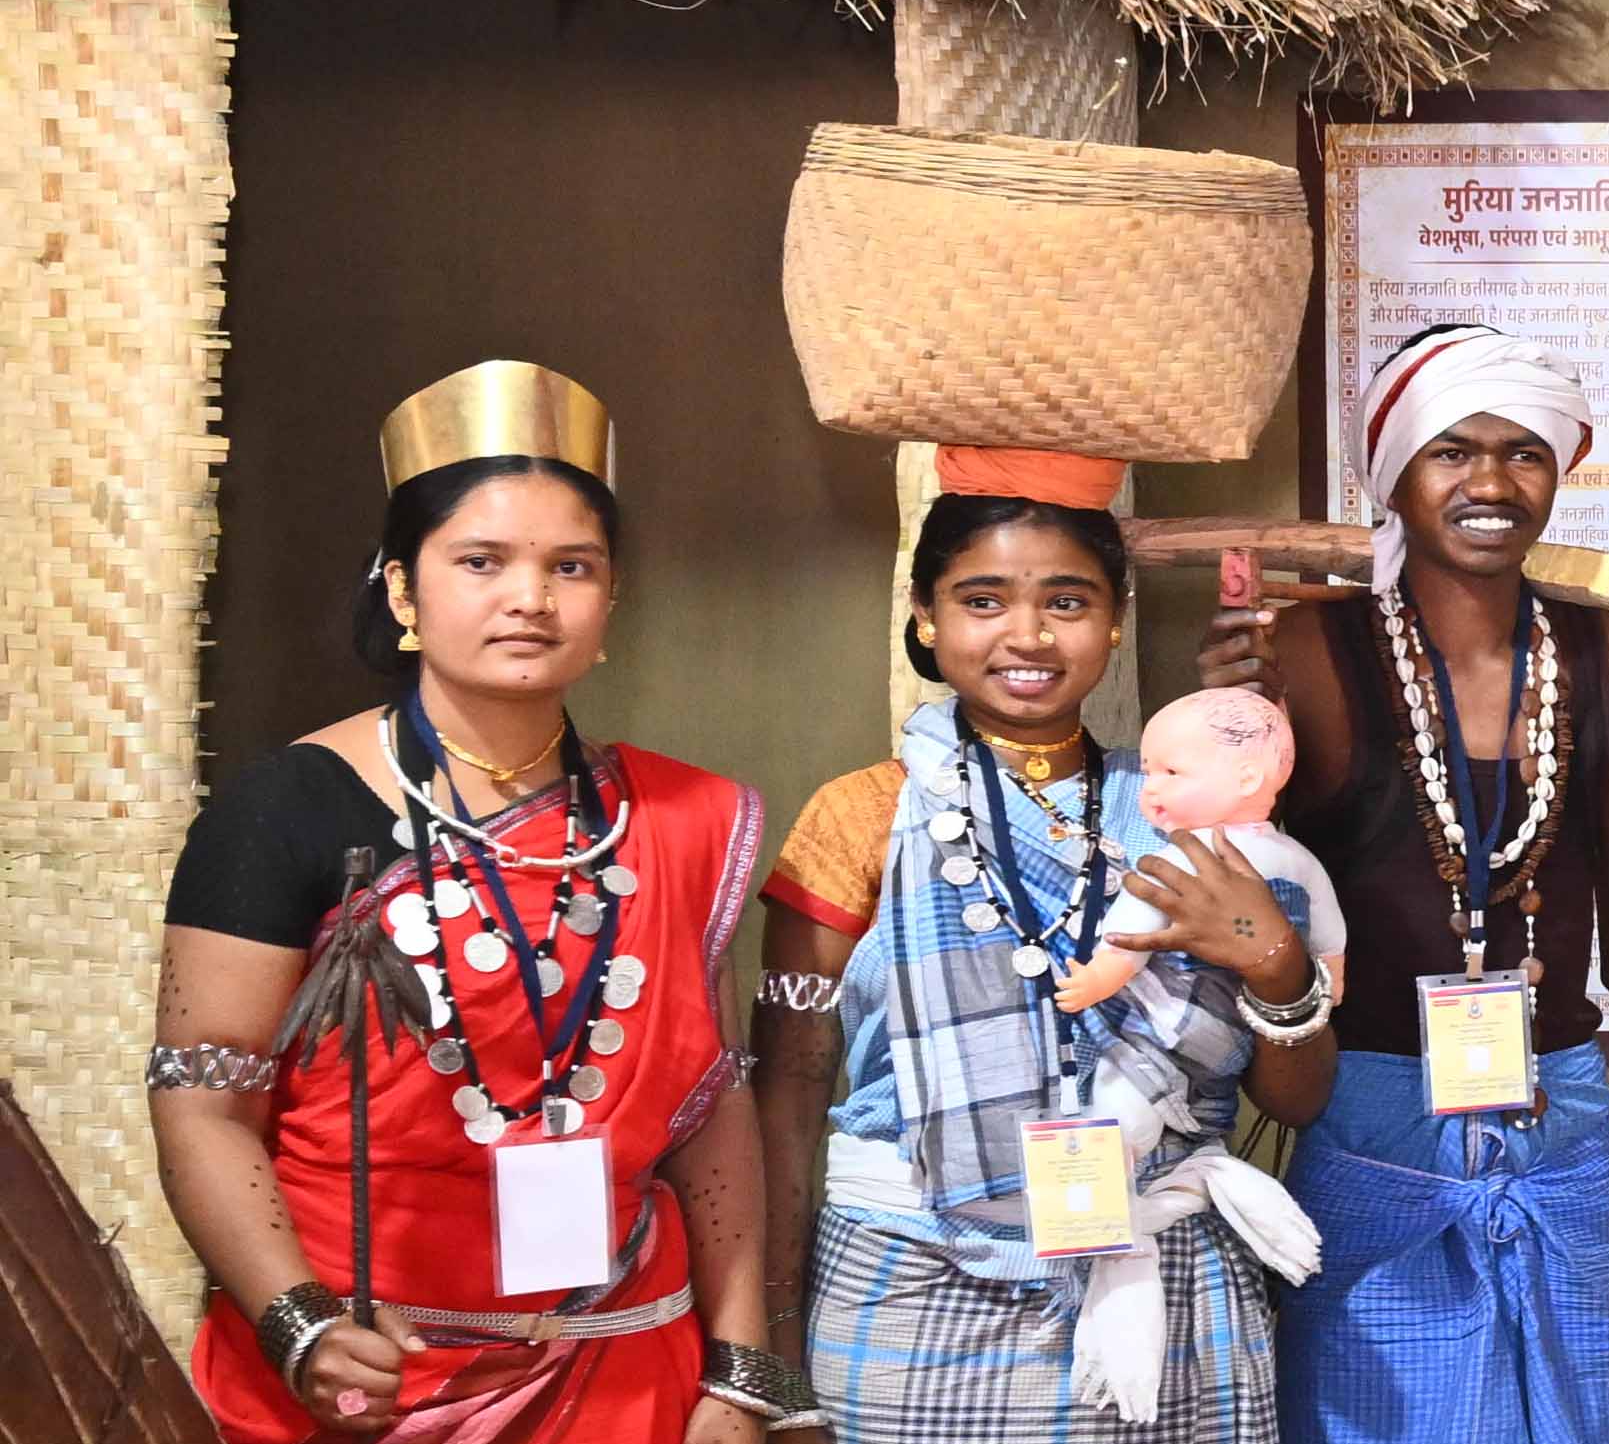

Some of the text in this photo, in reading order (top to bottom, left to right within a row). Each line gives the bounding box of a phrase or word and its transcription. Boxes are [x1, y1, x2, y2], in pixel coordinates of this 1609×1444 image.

[1443, 180, 1514, 222] मुरिया
[1419, 224, 1485, 252] वेशभूषा,
[1490, 226, 1537, 247] परंपरा
[1542, 226, 1567, 248] एवं
[1369, 278, 1404, 302] मुरिया
[1407, 278, 1456, 298] जनजाति
[1460, 278, 1518, 300] छत्तीसगढ़
[1521, 278, 1534, 297] के
[1537, 282, 1569, 297] बस्तर
[1575, 279, 1607, 297] अंचल
[1369, 307, 1392, 324] और
[1395, 307, 1433, 326] प्रसिद्ध
[1435, 305, 1484, 324] जनजाति
[1488, 305, 1503, 325] है।
[1507, 310, 1526, 325] यह
[1529, 306, 1578, 324] जनजाति
[1585, 331, 1597, 348] के
[1583, 468, 1602, 486] एवं
[1559, 504, 1604, 521] जनजाति
[1560, 526, 1608, 544] सामूहिक
